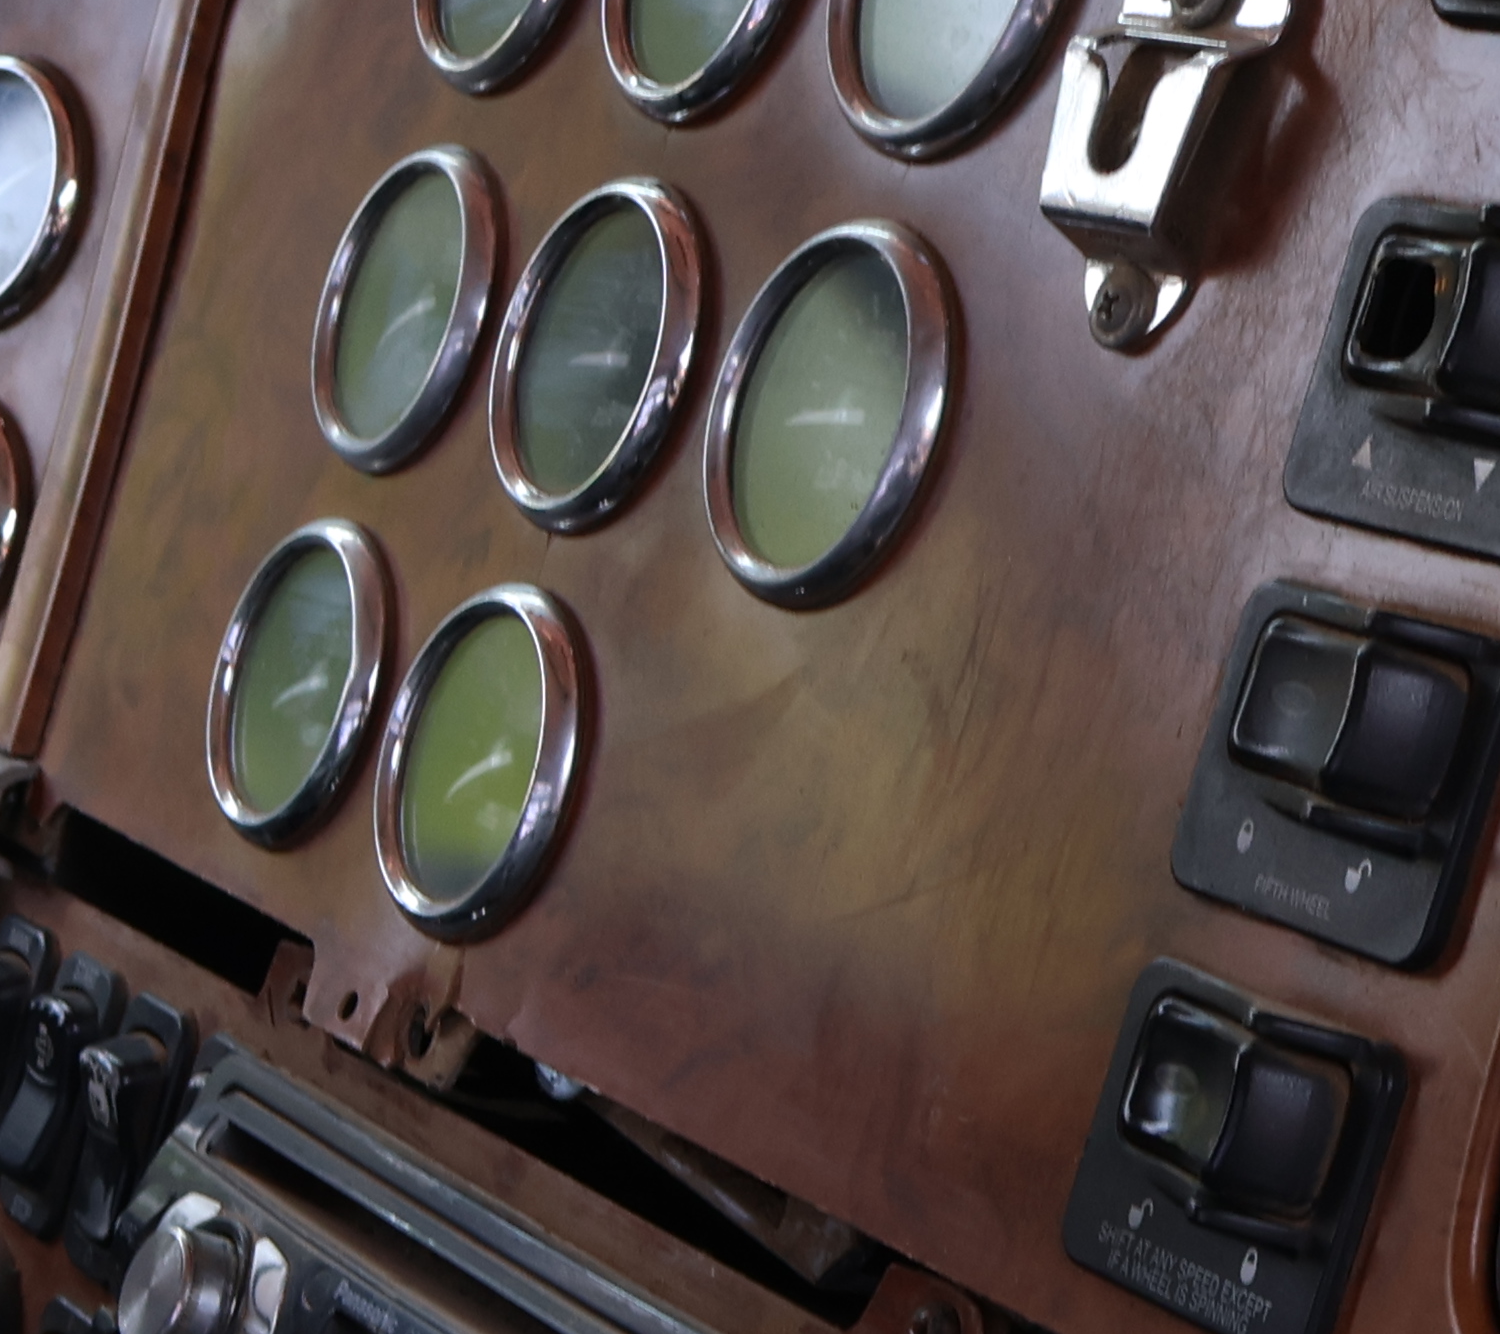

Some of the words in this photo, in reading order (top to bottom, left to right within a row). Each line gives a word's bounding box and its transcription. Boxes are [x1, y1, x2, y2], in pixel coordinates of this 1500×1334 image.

[1382, 484, 1464, 522] SUSPENSION
[1254, 873, 1289, 903] FIFTH
[1290, 886, 1330, 921] WHEEL
[1098, 1220, 1135, 1251] SHIFT
[1134, 1237, 1151, 1259] AT
[1150, 1247, 1177, 1271] ANY
[1177, 1257, 1220, 1296] SPEED
[1221, 1278, 1272, 1323] EXCEPT
[1107, 1248, 1121, 1270] IF
[1120, 1256, 1130, 1278] A
[1131, 1262, 1172, 1300] WHEEL
[1174, 1283, 1188, 1306] IS
